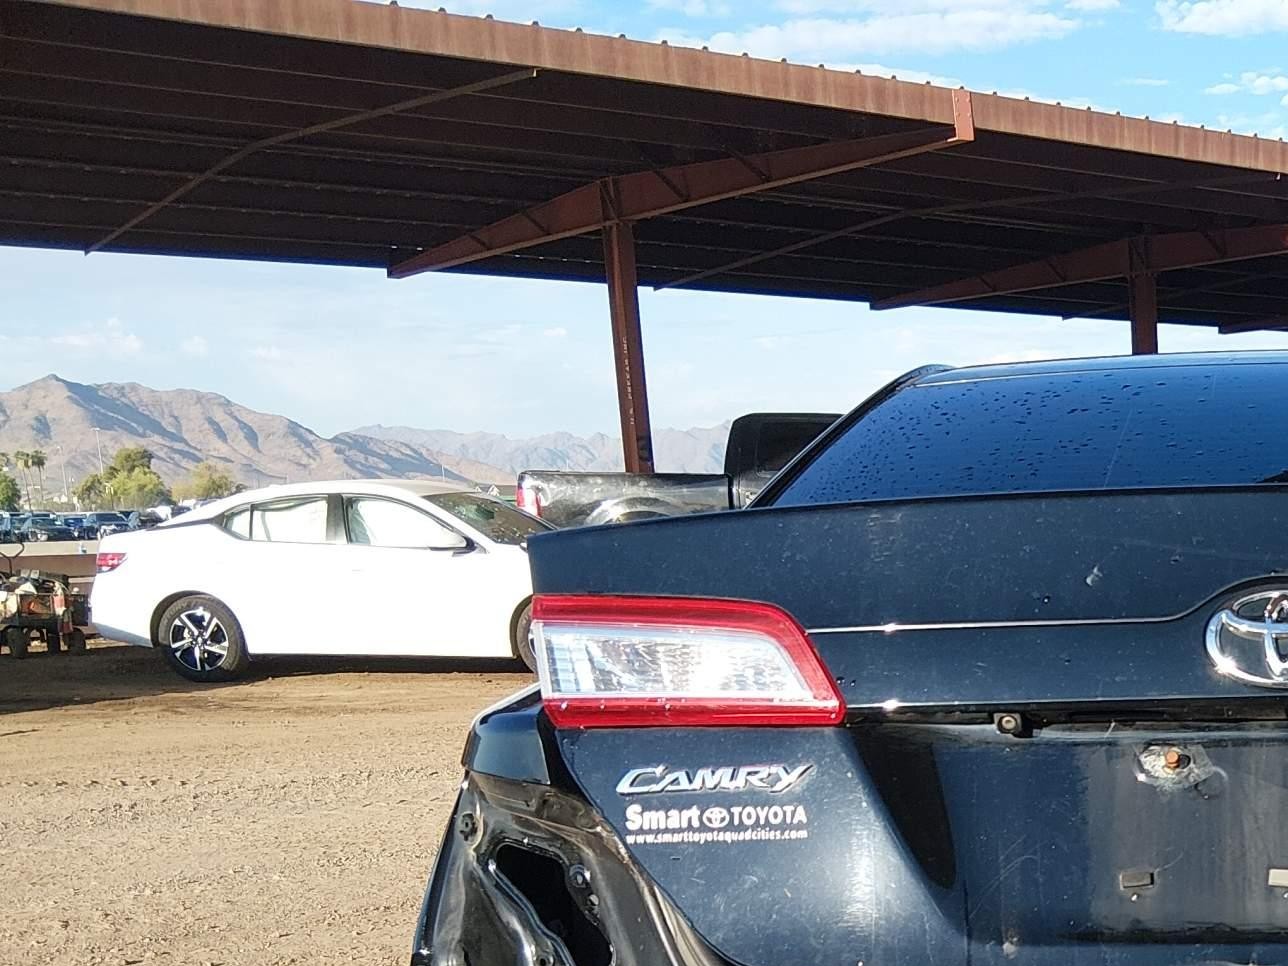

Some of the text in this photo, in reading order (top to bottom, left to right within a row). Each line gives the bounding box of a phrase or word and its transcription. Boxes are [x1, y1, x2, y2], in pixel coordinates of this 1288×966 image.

[616, 763, 815, 796] CAMRY
[625, 803, 808, 831] Smart TOYOTA
[625, 828, 808, 845] www.smarttoyotaquadcities.com
